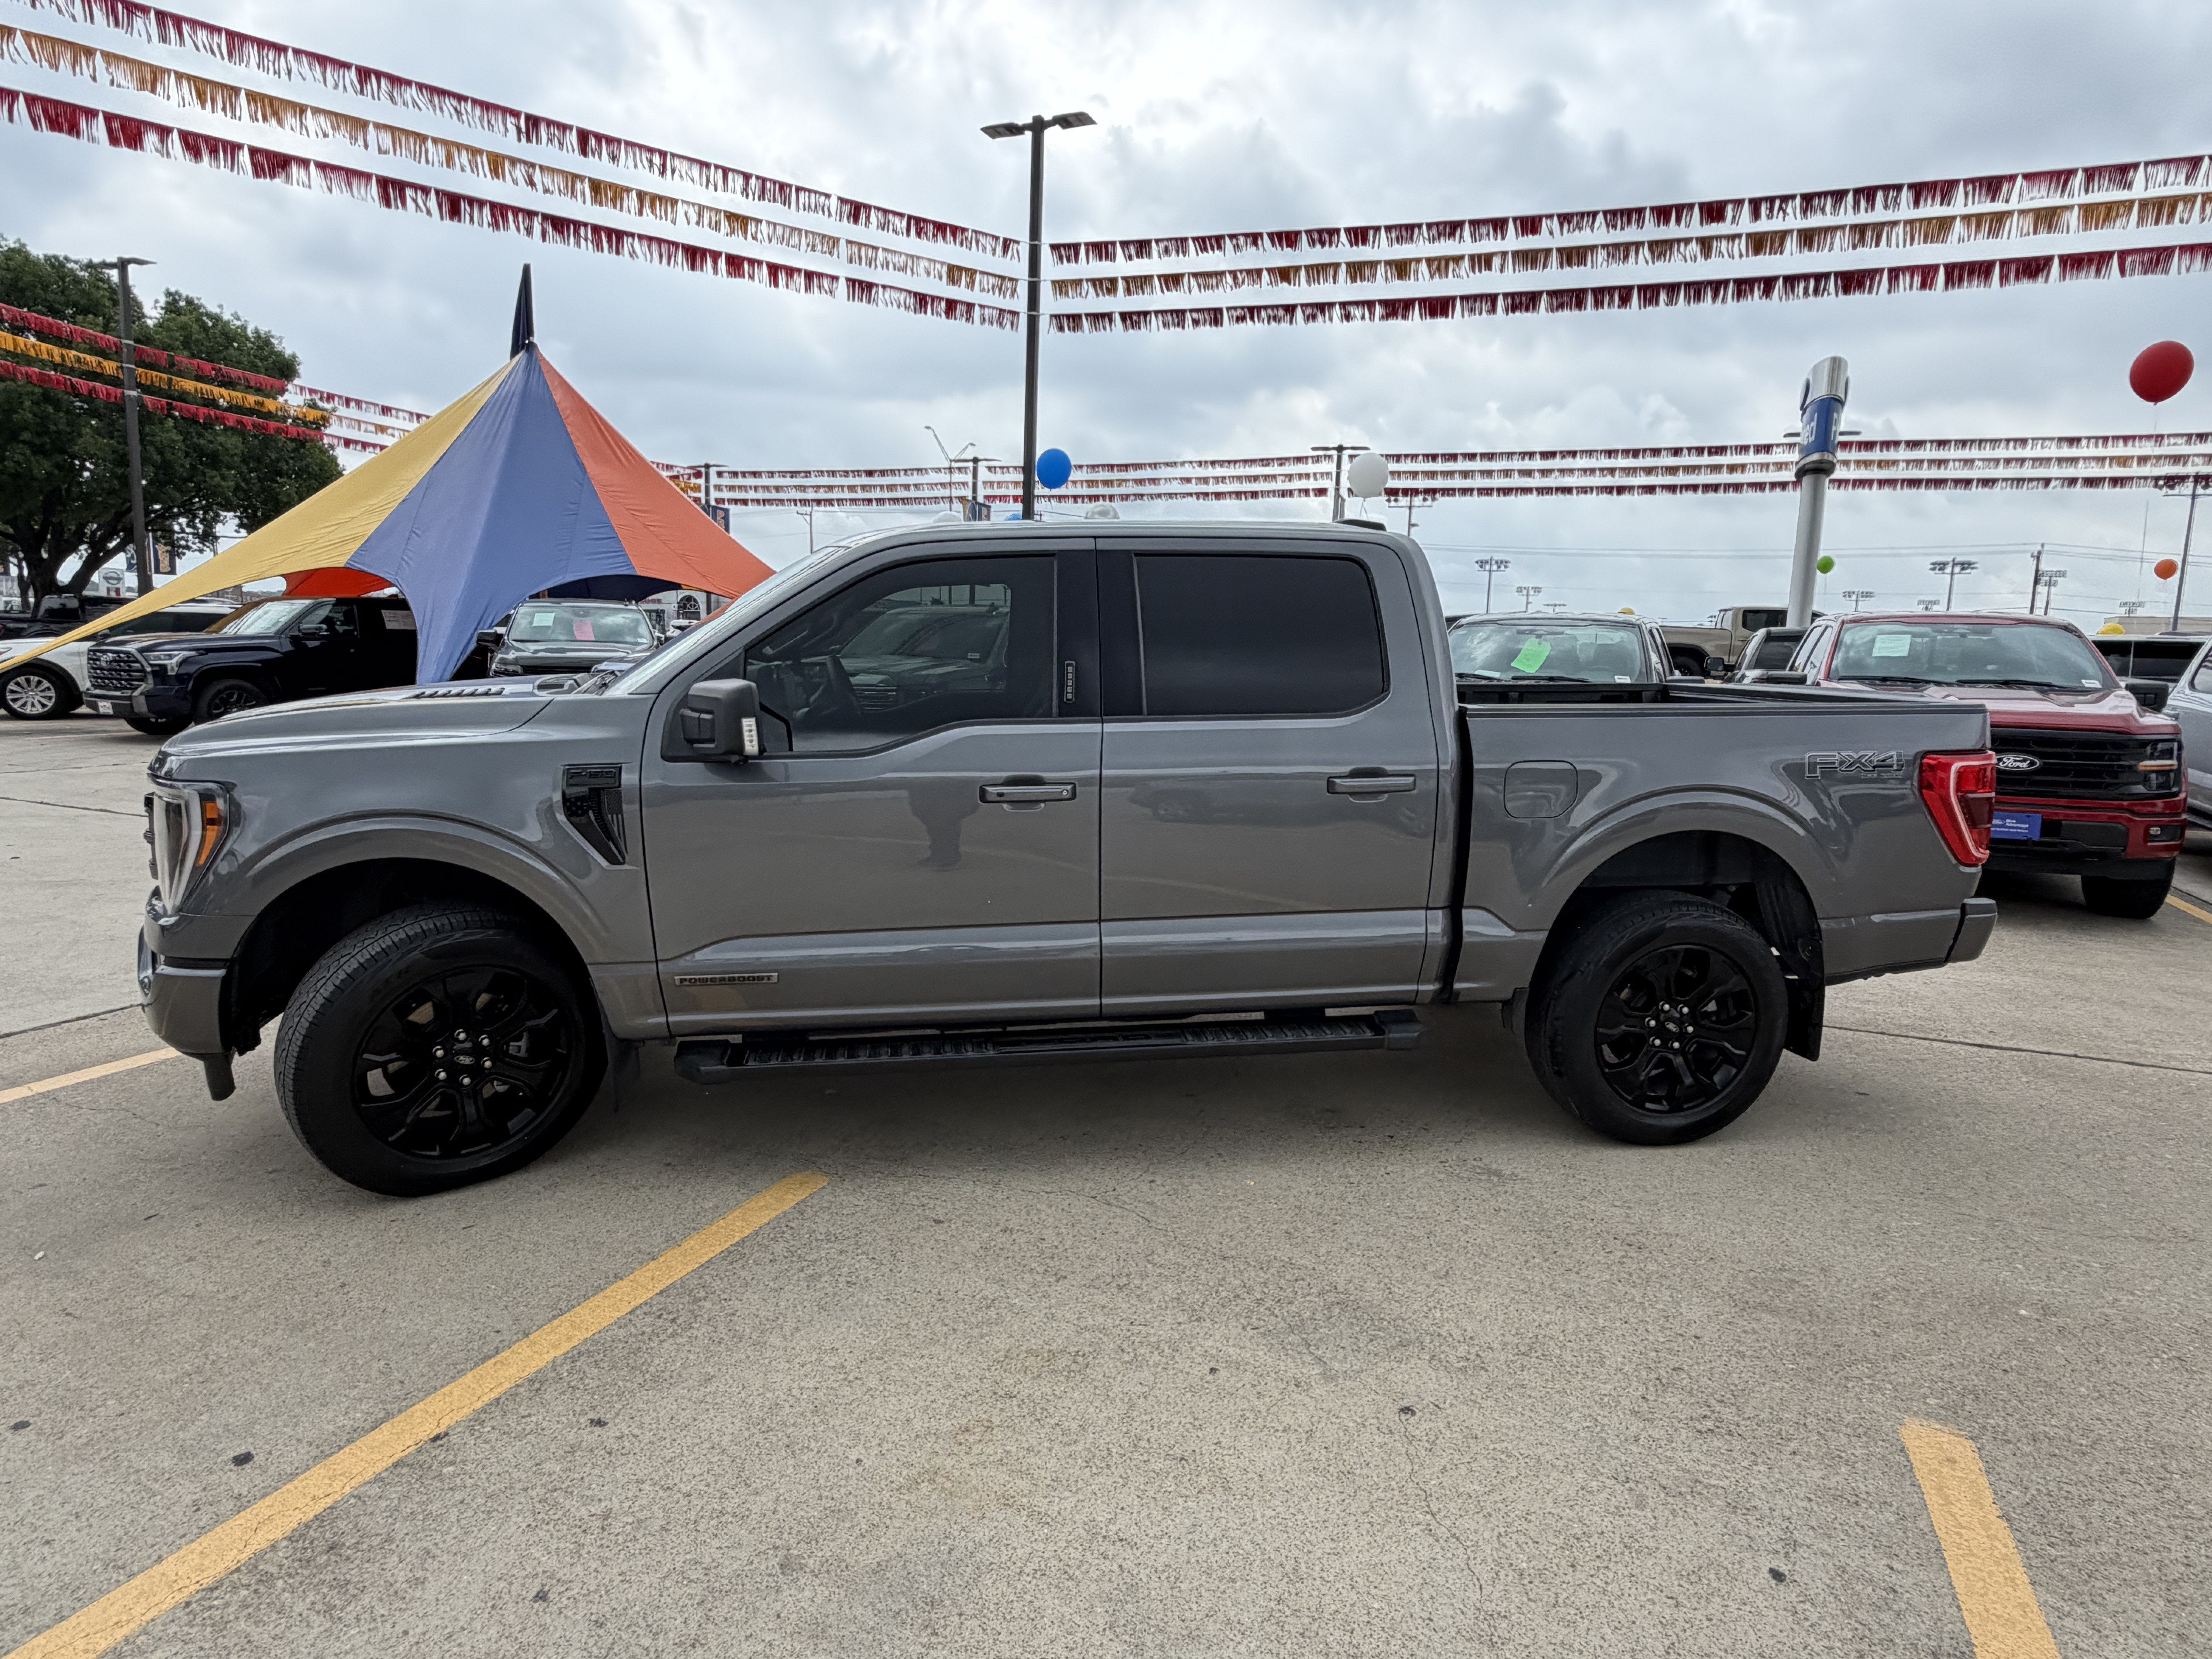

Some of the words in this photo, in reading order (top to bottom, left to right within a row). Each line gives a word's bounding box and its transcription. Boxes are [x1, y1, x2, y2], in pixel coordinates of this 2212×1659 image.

[1805, 750, 1905, 779] FX4
[1999, 756, 2030, 768] Ford
[679, 975, 773, 984] POWERBOOST
